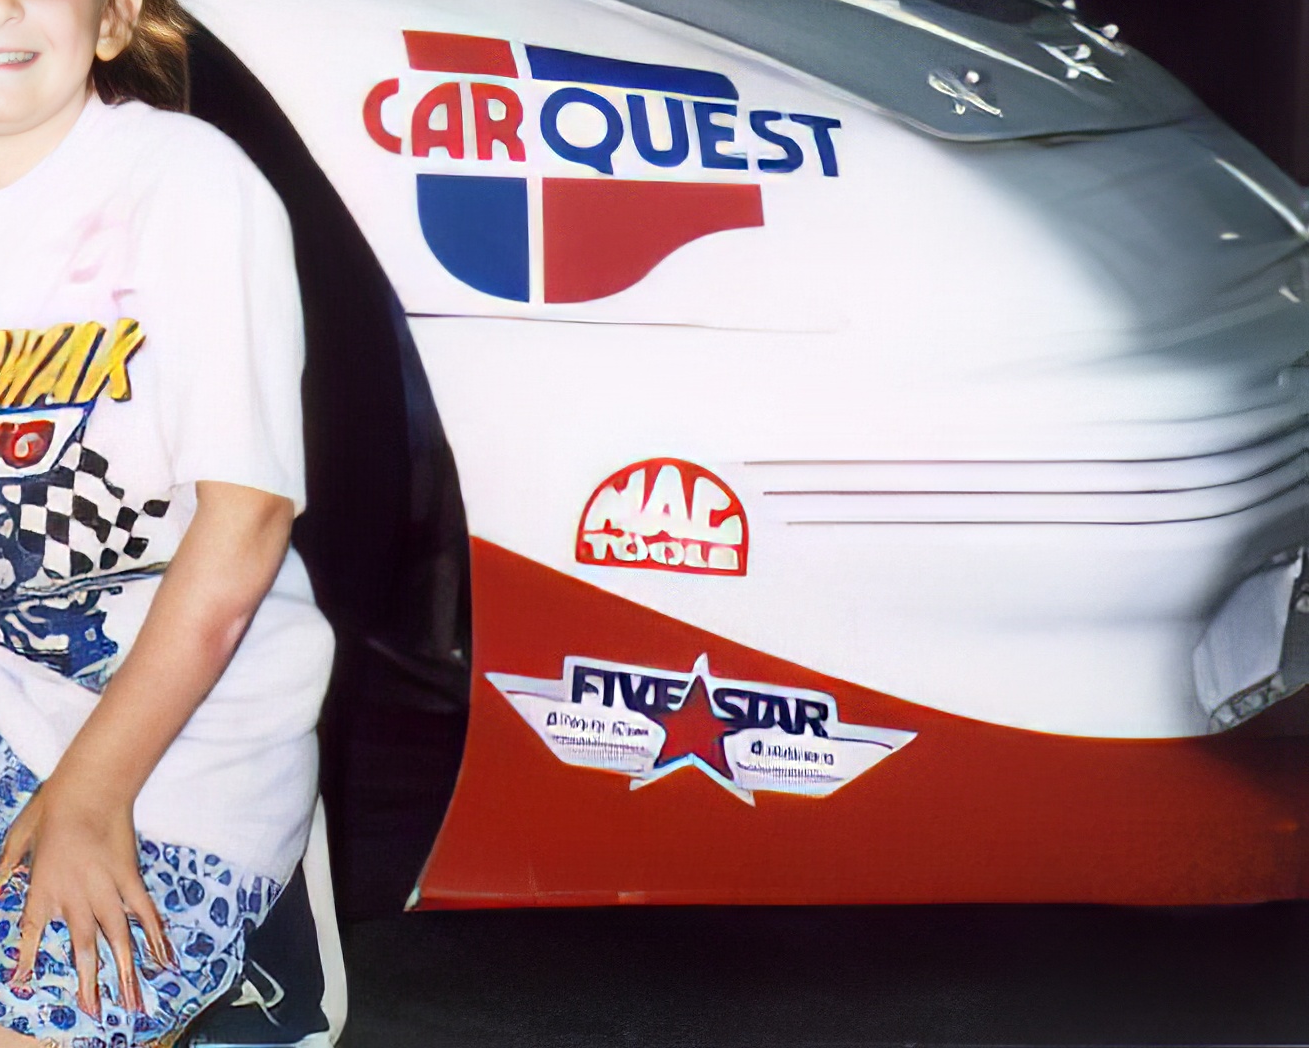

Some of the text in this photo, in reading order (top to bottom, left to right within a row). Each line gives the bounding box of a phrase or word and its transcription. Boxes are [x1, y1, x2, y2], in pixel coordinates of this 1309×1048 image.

[362, 76, 842, 178] CARQUEST
[585, 464, 743, 544] MAC
[571, 664, 691, 710] FIVE
[710, 686, 829, 738] STAR
